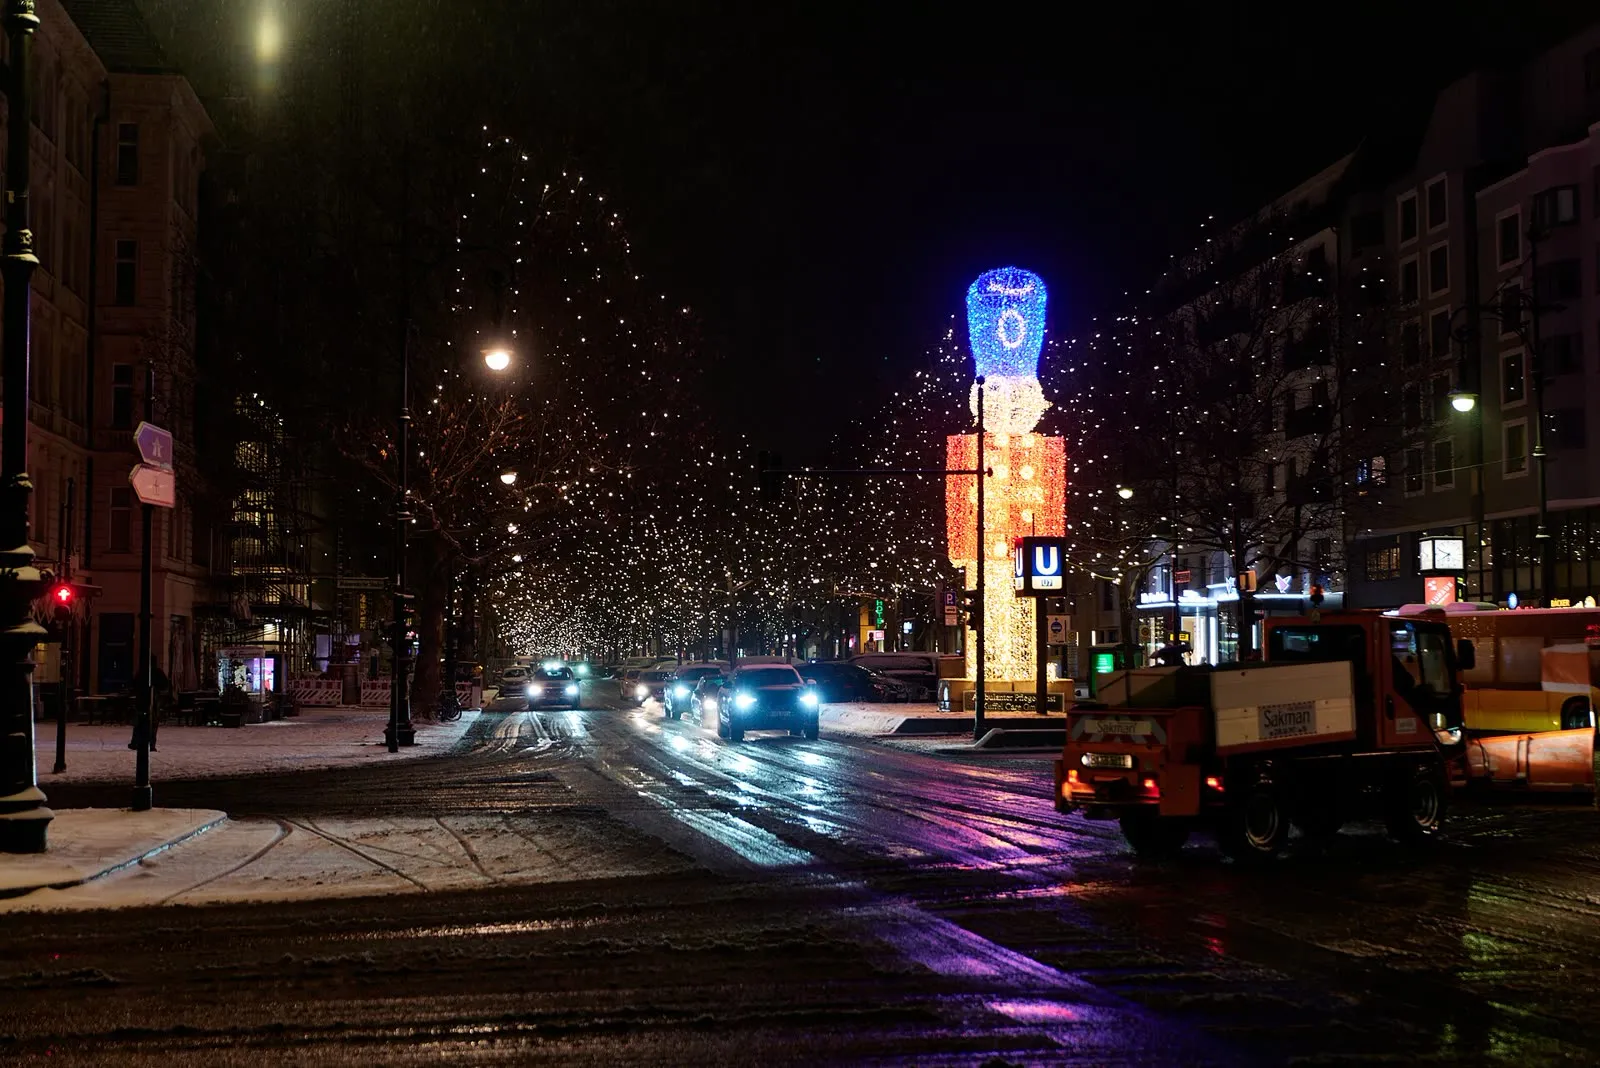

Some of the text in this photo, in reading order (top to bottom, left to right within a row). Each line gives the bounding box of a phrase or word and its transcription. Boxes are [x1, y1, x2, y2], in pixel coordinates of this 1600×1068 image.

[1015, 547, 1023, 577] U
[1035, 546, 1058, 576] U
[946, 593, 953, 605] P
[1427, 581, 1454, 605] AUHAUS
[971, 693, 1014, 702] Abulanter
[1096, 720, 1136, 734] Sakman
[1264, 708, 1310, 729] Sakman
